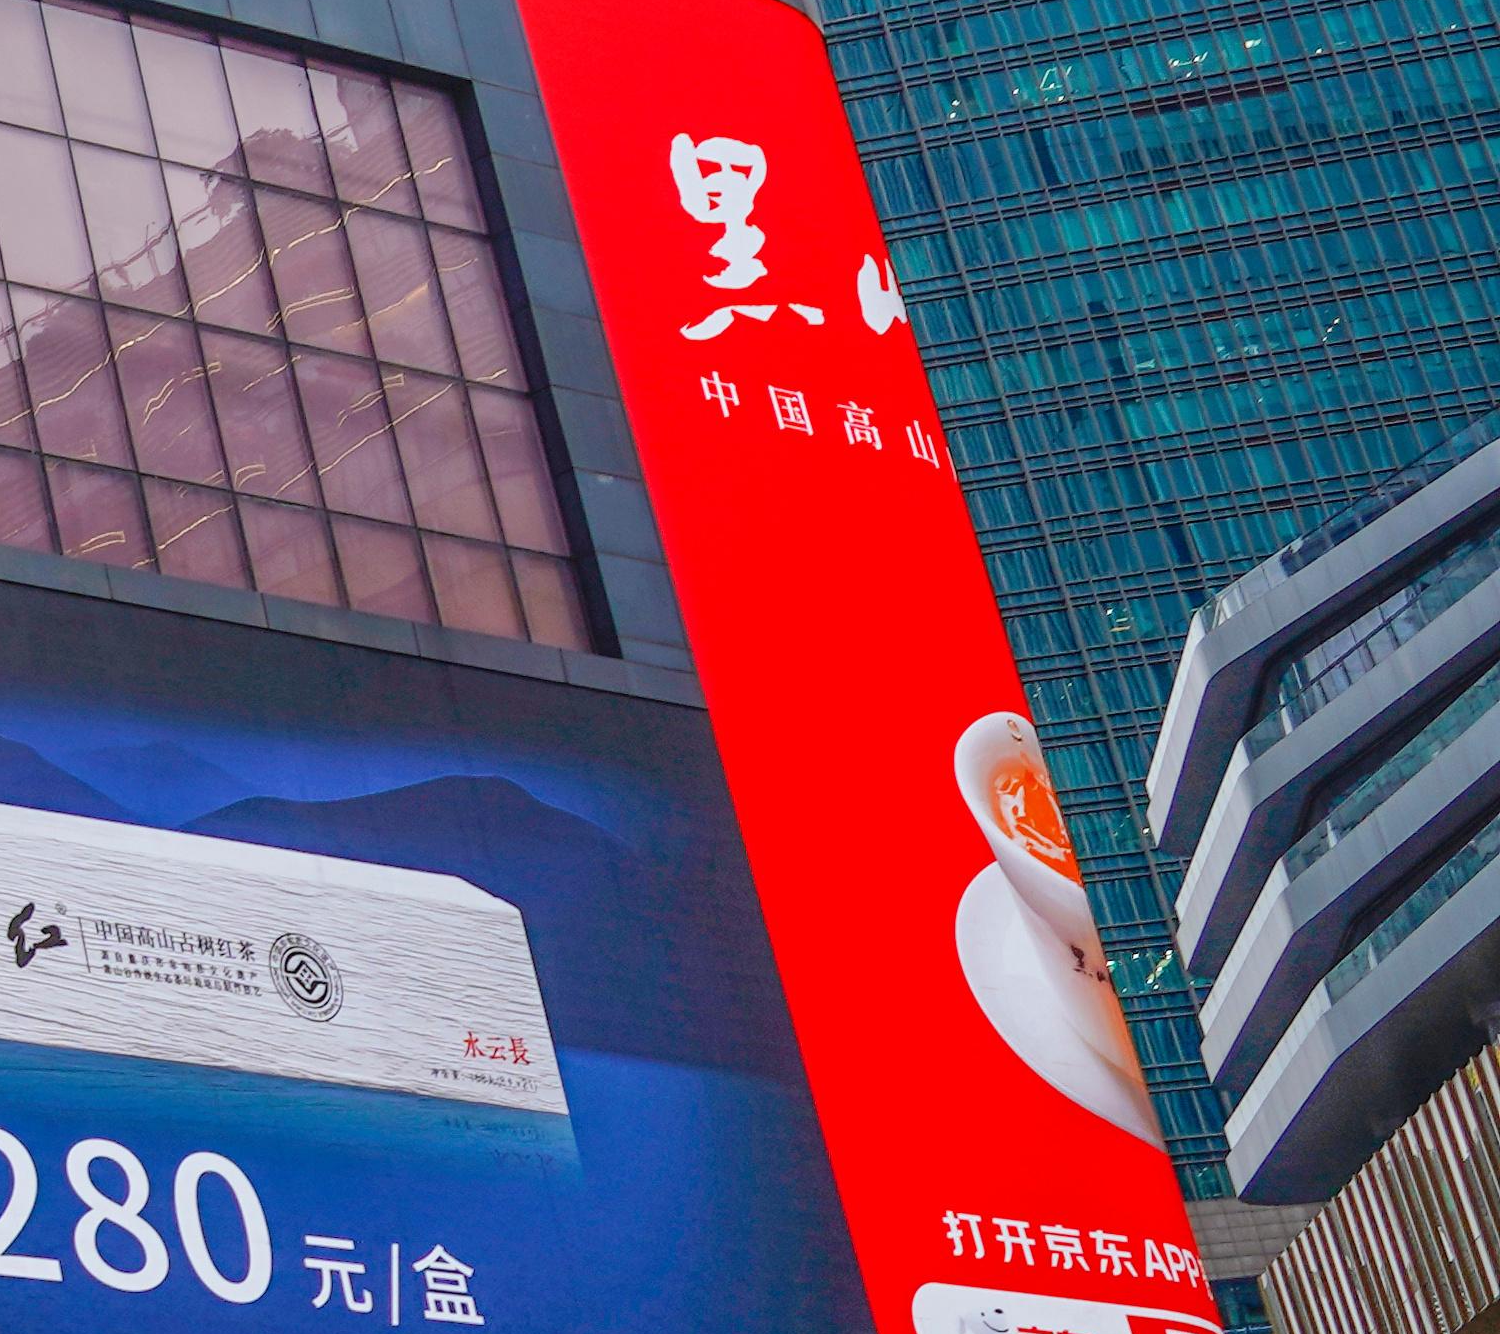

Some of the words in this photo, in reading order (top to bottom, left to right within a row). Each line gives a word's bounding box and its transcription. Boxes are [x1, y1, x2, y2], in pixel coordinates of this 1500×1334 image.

[700, 371, 957, 482] 中国高山
[95, 919, 257, 963] 中国高山古树红茶
[301, 1233, 486, 1328] 元/盒
[942, 1210, 1214, 1301] 打开京东APP
